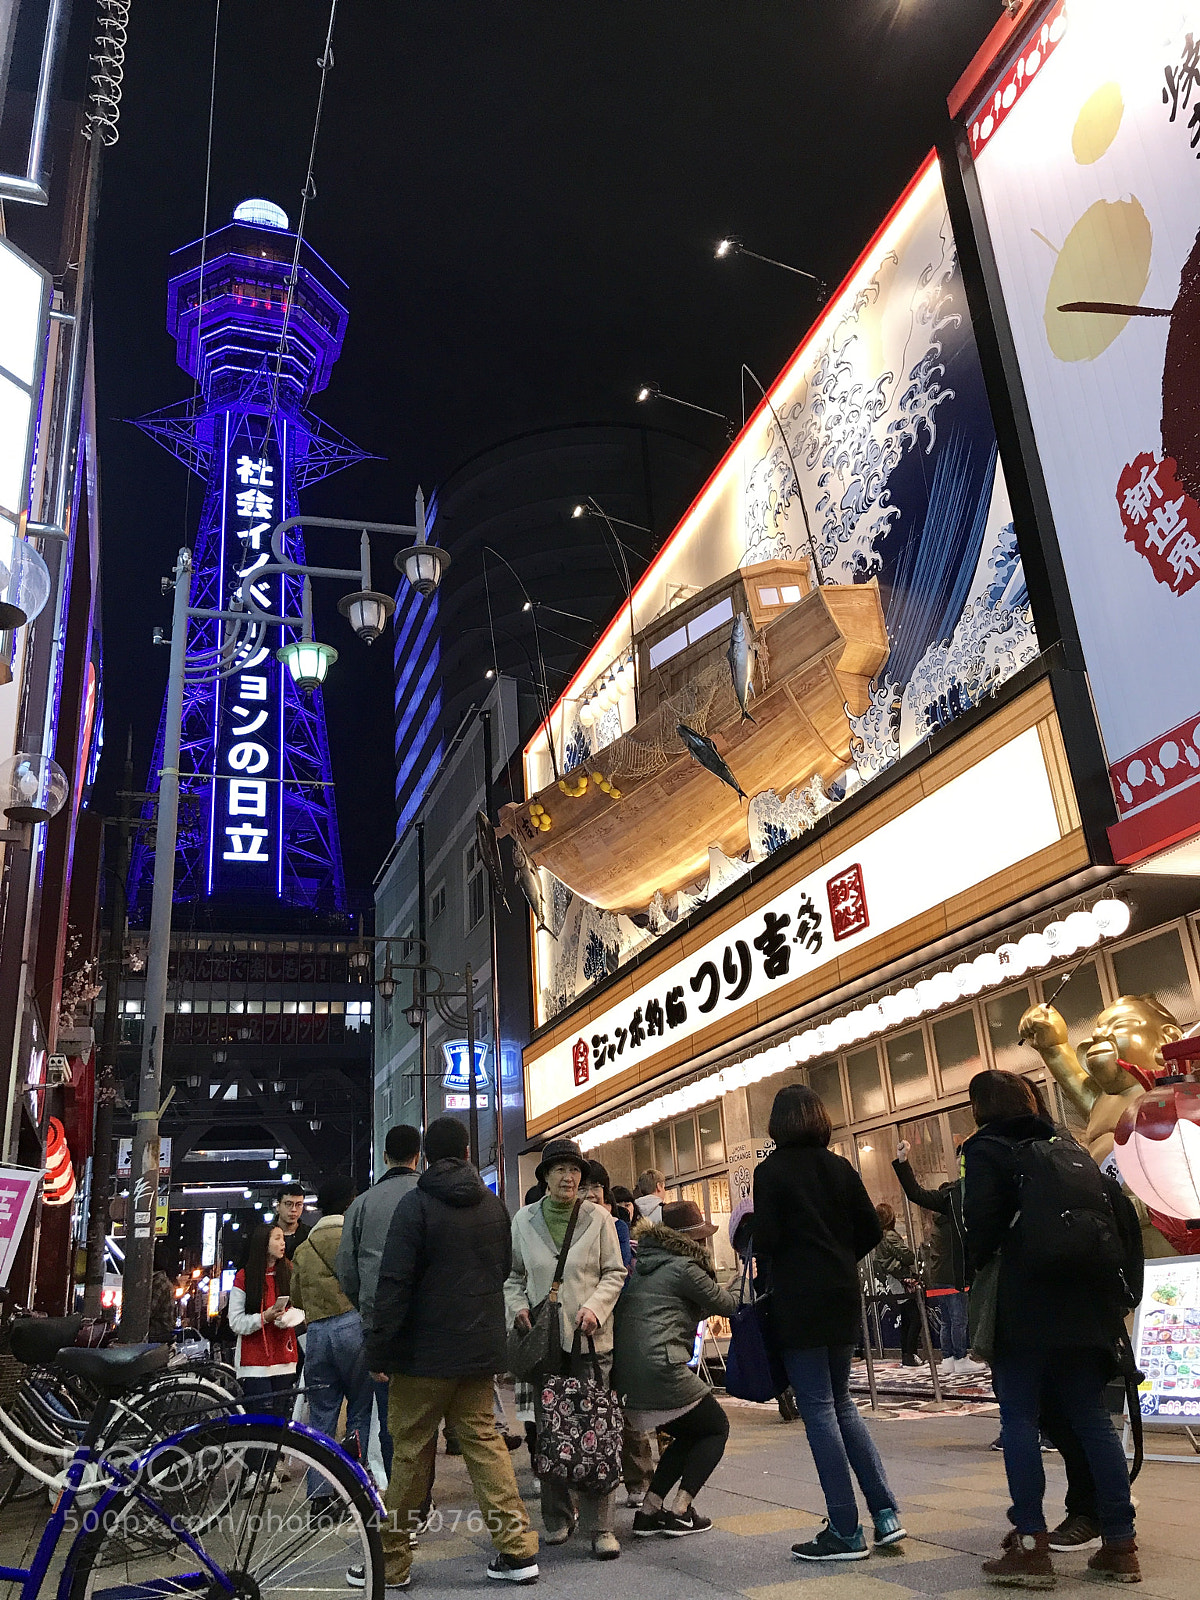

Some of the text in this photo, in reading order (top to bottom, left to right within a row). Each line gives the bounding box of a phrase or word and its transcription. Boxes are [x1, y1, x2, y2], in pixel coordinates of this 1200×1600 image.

[1122, 465, 1200, 586] 新世界
[448, 1096, 487, 1107] 酒たこ
[1168, 1401, 1200, 1416] 06-66
